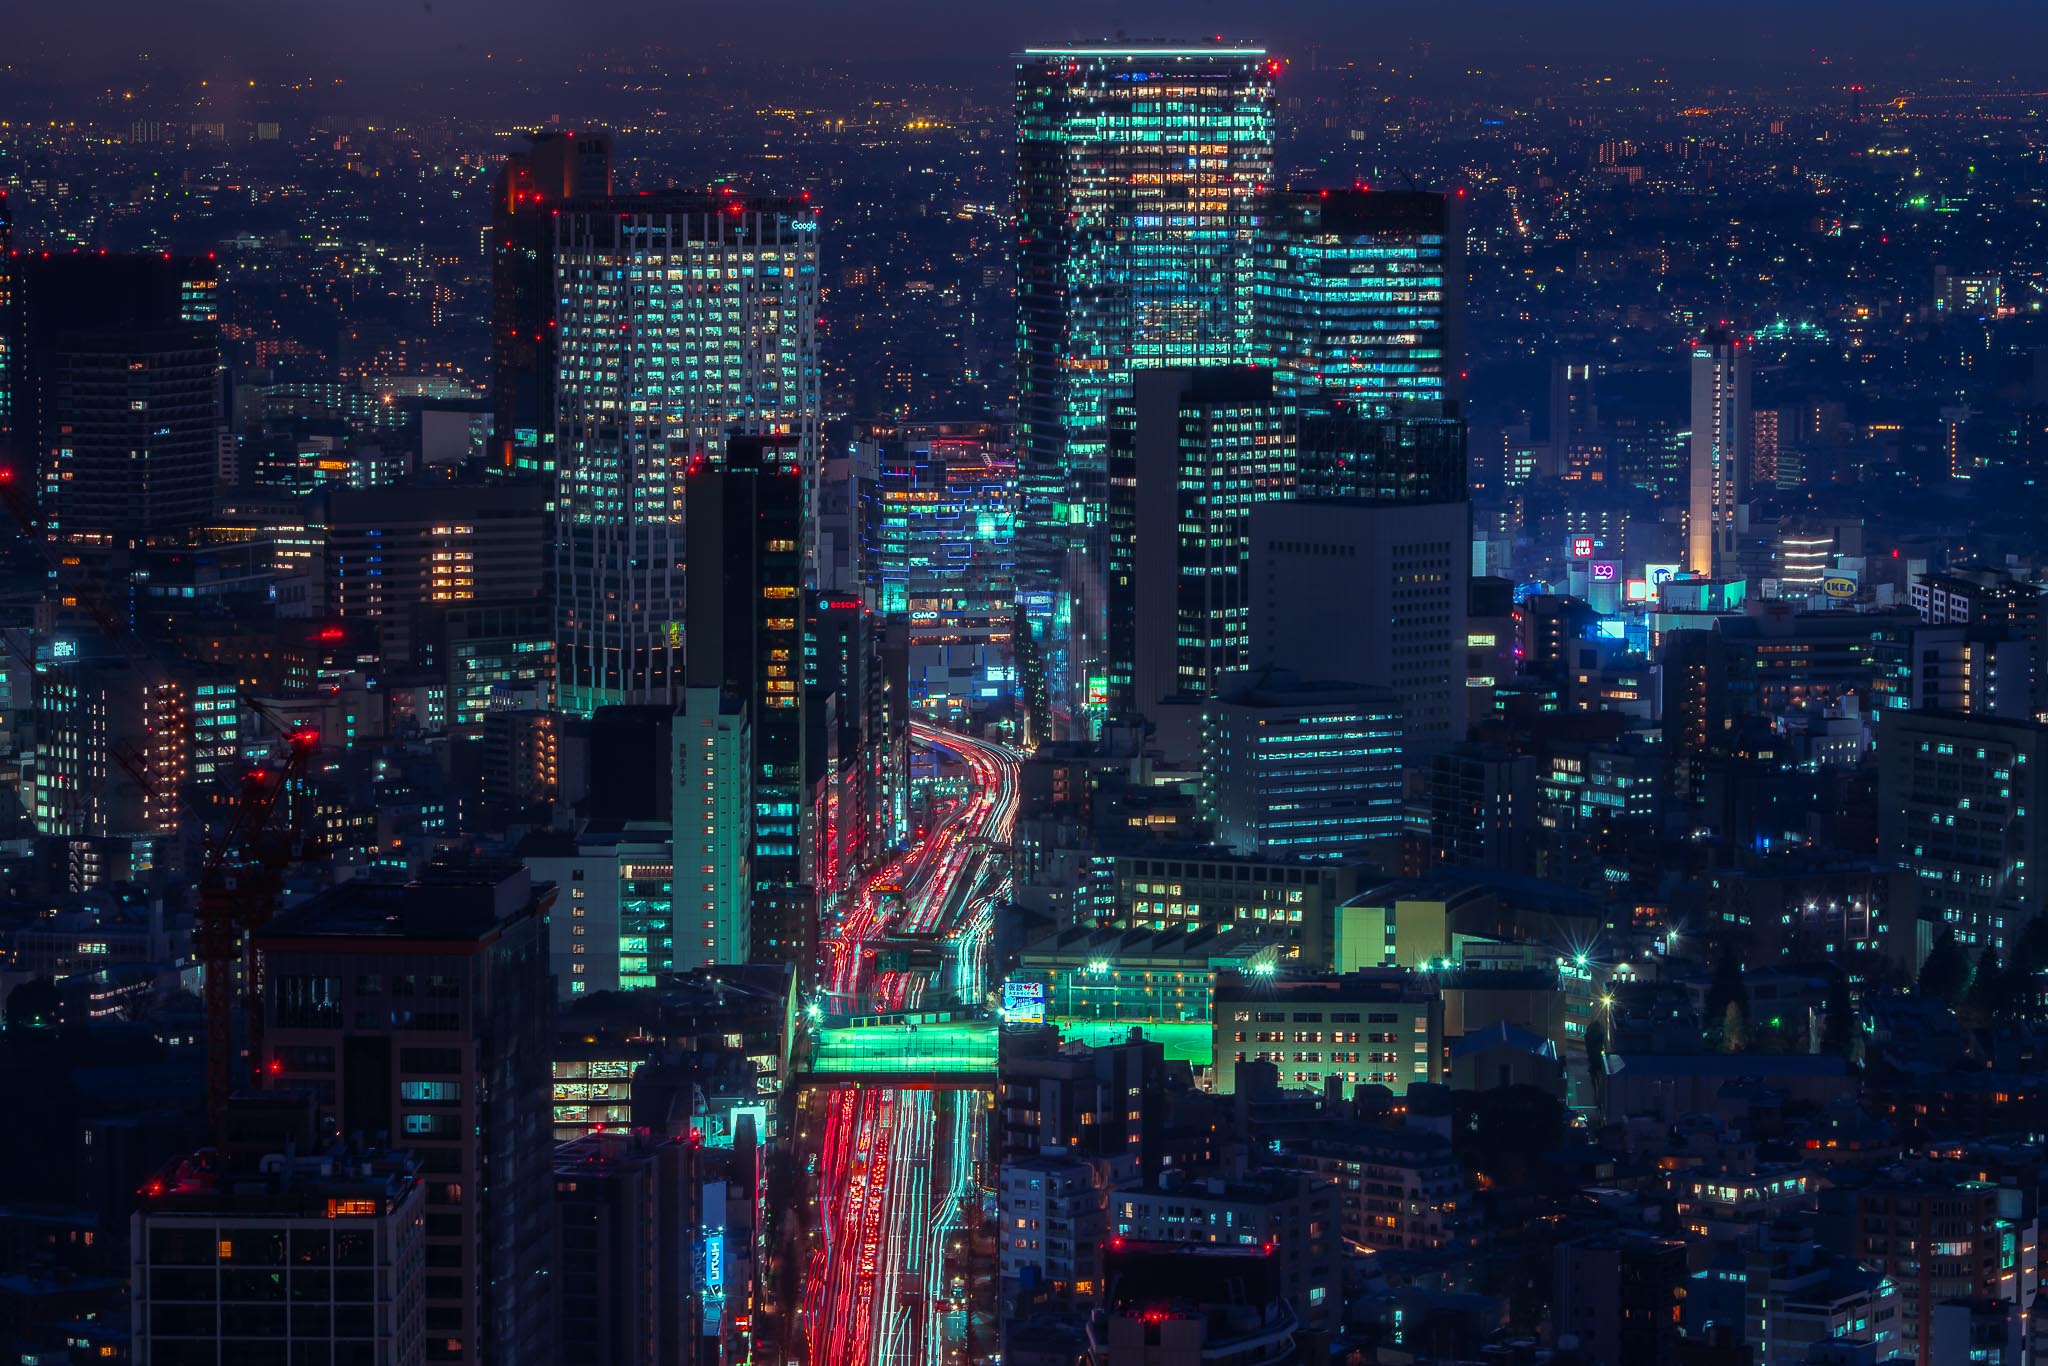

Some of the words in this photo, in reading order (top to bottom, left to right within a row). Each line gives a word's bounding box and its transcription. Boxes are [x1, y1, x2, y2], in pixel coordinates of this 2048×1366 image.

[792, 220, 817, 232] Google
[1576, 540, 1589, 548] UNI
[1575, 547, 1590, 556] QLO
[1593, 565, 1614, 580] 109
[1827, 582, 1854, 592] IKEA
[830, 601, 856, 609] BOSCH
[912, 611, 938, 619] GMO
